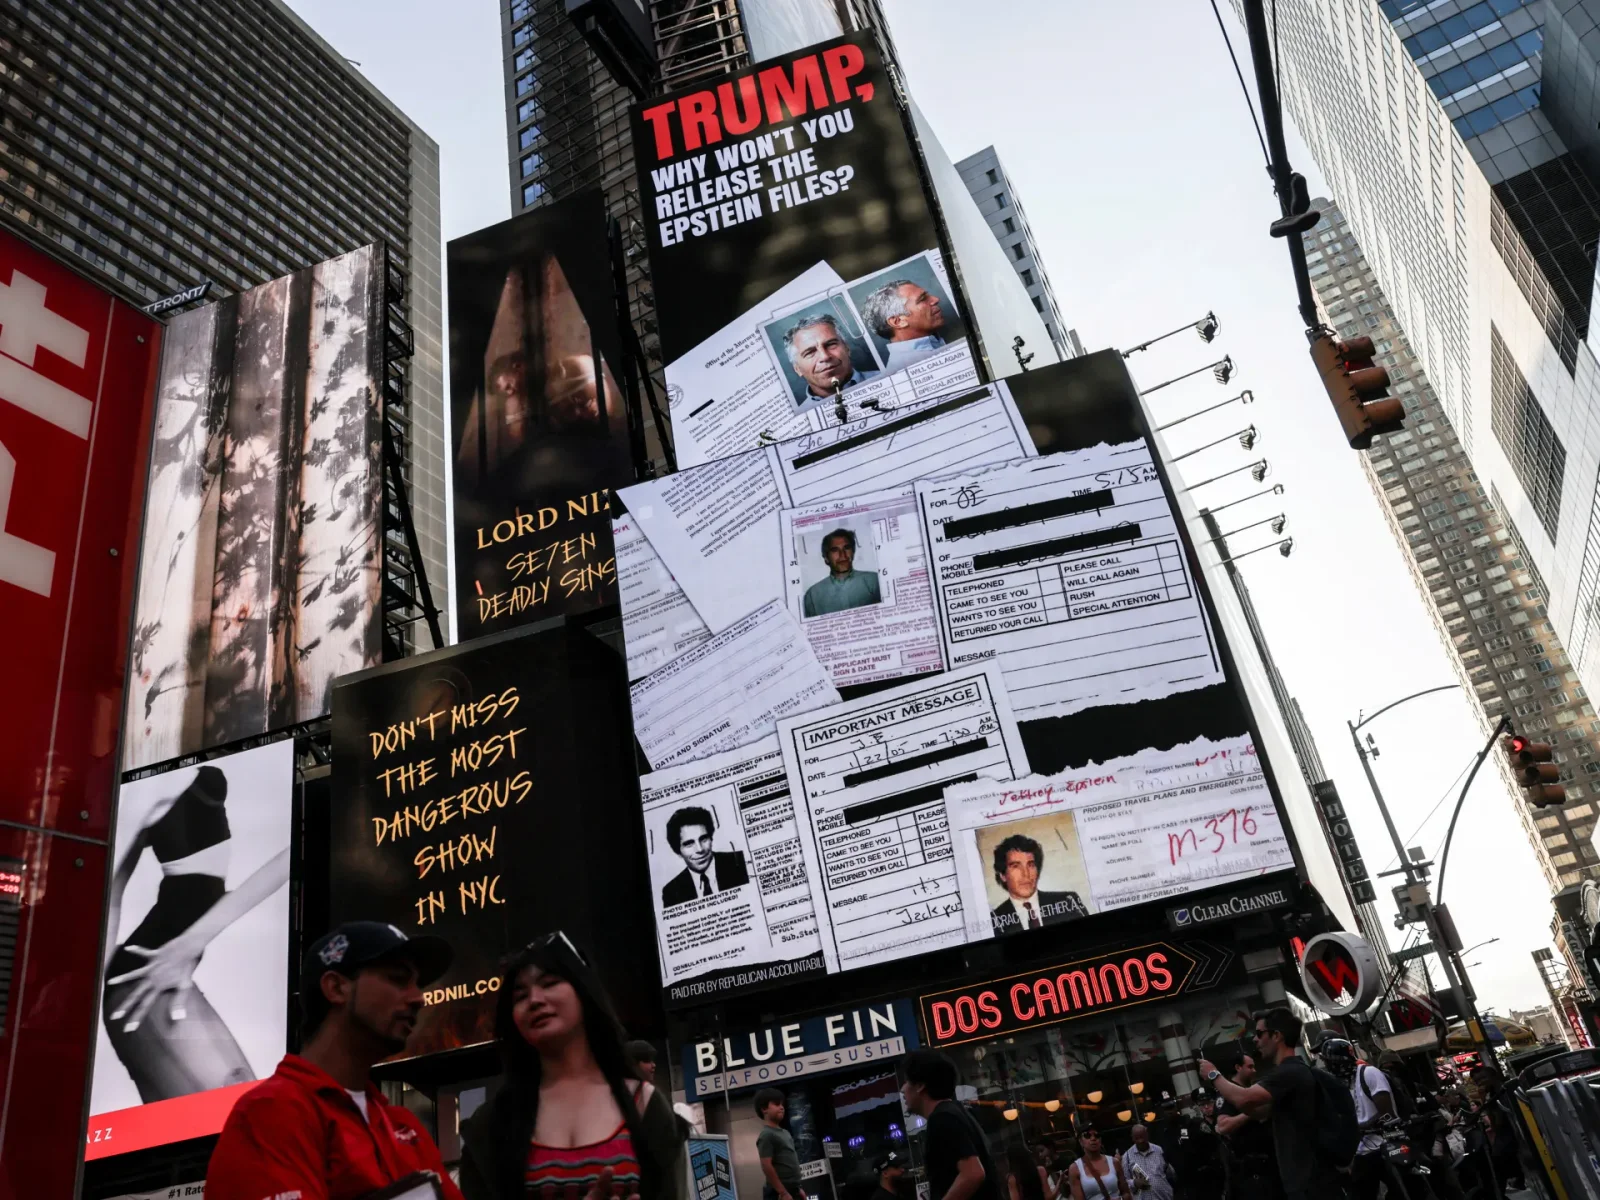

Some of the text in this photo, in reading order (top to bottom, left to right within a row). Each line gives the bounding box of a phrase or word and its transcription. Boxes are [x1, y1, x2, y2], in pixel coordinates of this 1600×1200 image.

[643, 44, 874, 160] TRUMP,
[652, 108, 854, 192] WHY WON'T YOU
[656, 148, 817, 219] RELEASE THE
[659, 165, 854, 247] EPSTEIN FILES?
[910, 351, 965, 376] WILL CALL AGAIN
[853, 382, 883, 397] SEE YOU
[913, 374, 934, 385] RUSH
[917, 380, 946, 394] SPECIAL
[930, 499, 947, 508] FOR
[932, 515, 954, 525] DATE
[1072, 487, 1092, 497] TIME
[477, 507, 558, 550] LORD
[506, 532, 596, 581] SE7EN
[939, 553, 950, 561] OF
[940, 560, 973, 573] PHONE/
[1063, 556, 1121, 573] PLEASE CALL
[941, 568, 973, 580] MOBILE
[1066, 567, 1139, 587] WILL CALL AGAIN
[477, 576, 550, 624] DEADLY
[560, 558, 616, 598] SINS
[947, 579, 1004, 596] TELEPHONED
[949, 588, 1028, 610] CAME TO SEE YOU
[1069, 590, 1095, 601] RUSH
[951, 601, 1037, 623] WANTS TO SEE YOU
[1072, 592, 1160, 615] SPECIAL ATTENTION
[954, 614, 1043, 638] RETURNED YOUR CALL
[832, 653, 891, 669] APPLICANT MUST
[953, 649, 996, 663] MESSAGE
[832, 663, 875, 677] SIGN DATE
[370, 687, 519, 760] DON'T MISS
[809, 687, 974, 744] IMPORTANT MESSAGE
[654, 720, 731, 770] OATH AND SIGNATURE
[376, 727, 527, 798] THE MOST
[804, 756, 819, 765] FOR
[807, 771, 825, 781] DATE
[921, 739, 938, 749] TIME
[736, 769, 780, 786] FATHER'S NAME
[1082, 801, 1122, 815] PROPOSED
[1124, 795, 1152, 806] TRAVEL
[1153, 790, 1178, 801] PLANS
[1179, 786, 1196, 796] AND
[1198, 777, 1245, 792] EMERGENCY
[372, 771, 533, 847] DANGEROUS
[814, 807, 825, 815] OF
[816, 812, 844, 826] PHONE/
[917, 807, 945, 820] PLEASE
[817, 819, 844, 832] MOBILE
[823, 828, 870, 846] TELEPHONED
[920, 823, 937, 833] WILL
[826, 836, 891, 859] CAME TO SEE YOU
[923, 835, 944, 846] RUSH
[1326, 803, 1371, 898] HOTEL
[414, 826, 496, 879] SHOW
[828, 847, 898, 872] WANTS TO SEE YOU
[831, 859, 904, 885] RETURNED YOUR CALL
[415, 875, 506, 925] IN NYC.
[684, 891, 728, 908] REQUIREMENTS
[832, 893, 868, 909] MESSAGE
[1141, 884, 1189, 900] INFORMATION
[662, 909, 688, 920] PERSONS
[672, 945, 745, 972] CONSULATE WILL STAPLE
[670, 954, 825, 1000] PAID FOR BY REPUBLICAN ACCOUNTABILI
[423, 977, 500, 1006] RDNIL.CO
[932, 952, 1173, 1039] DOS CAMINOS
[695, 1003, 898, 1073] BLUE FIN
[700, 1041, 902, 1091] SEAFOOD SUSHI
